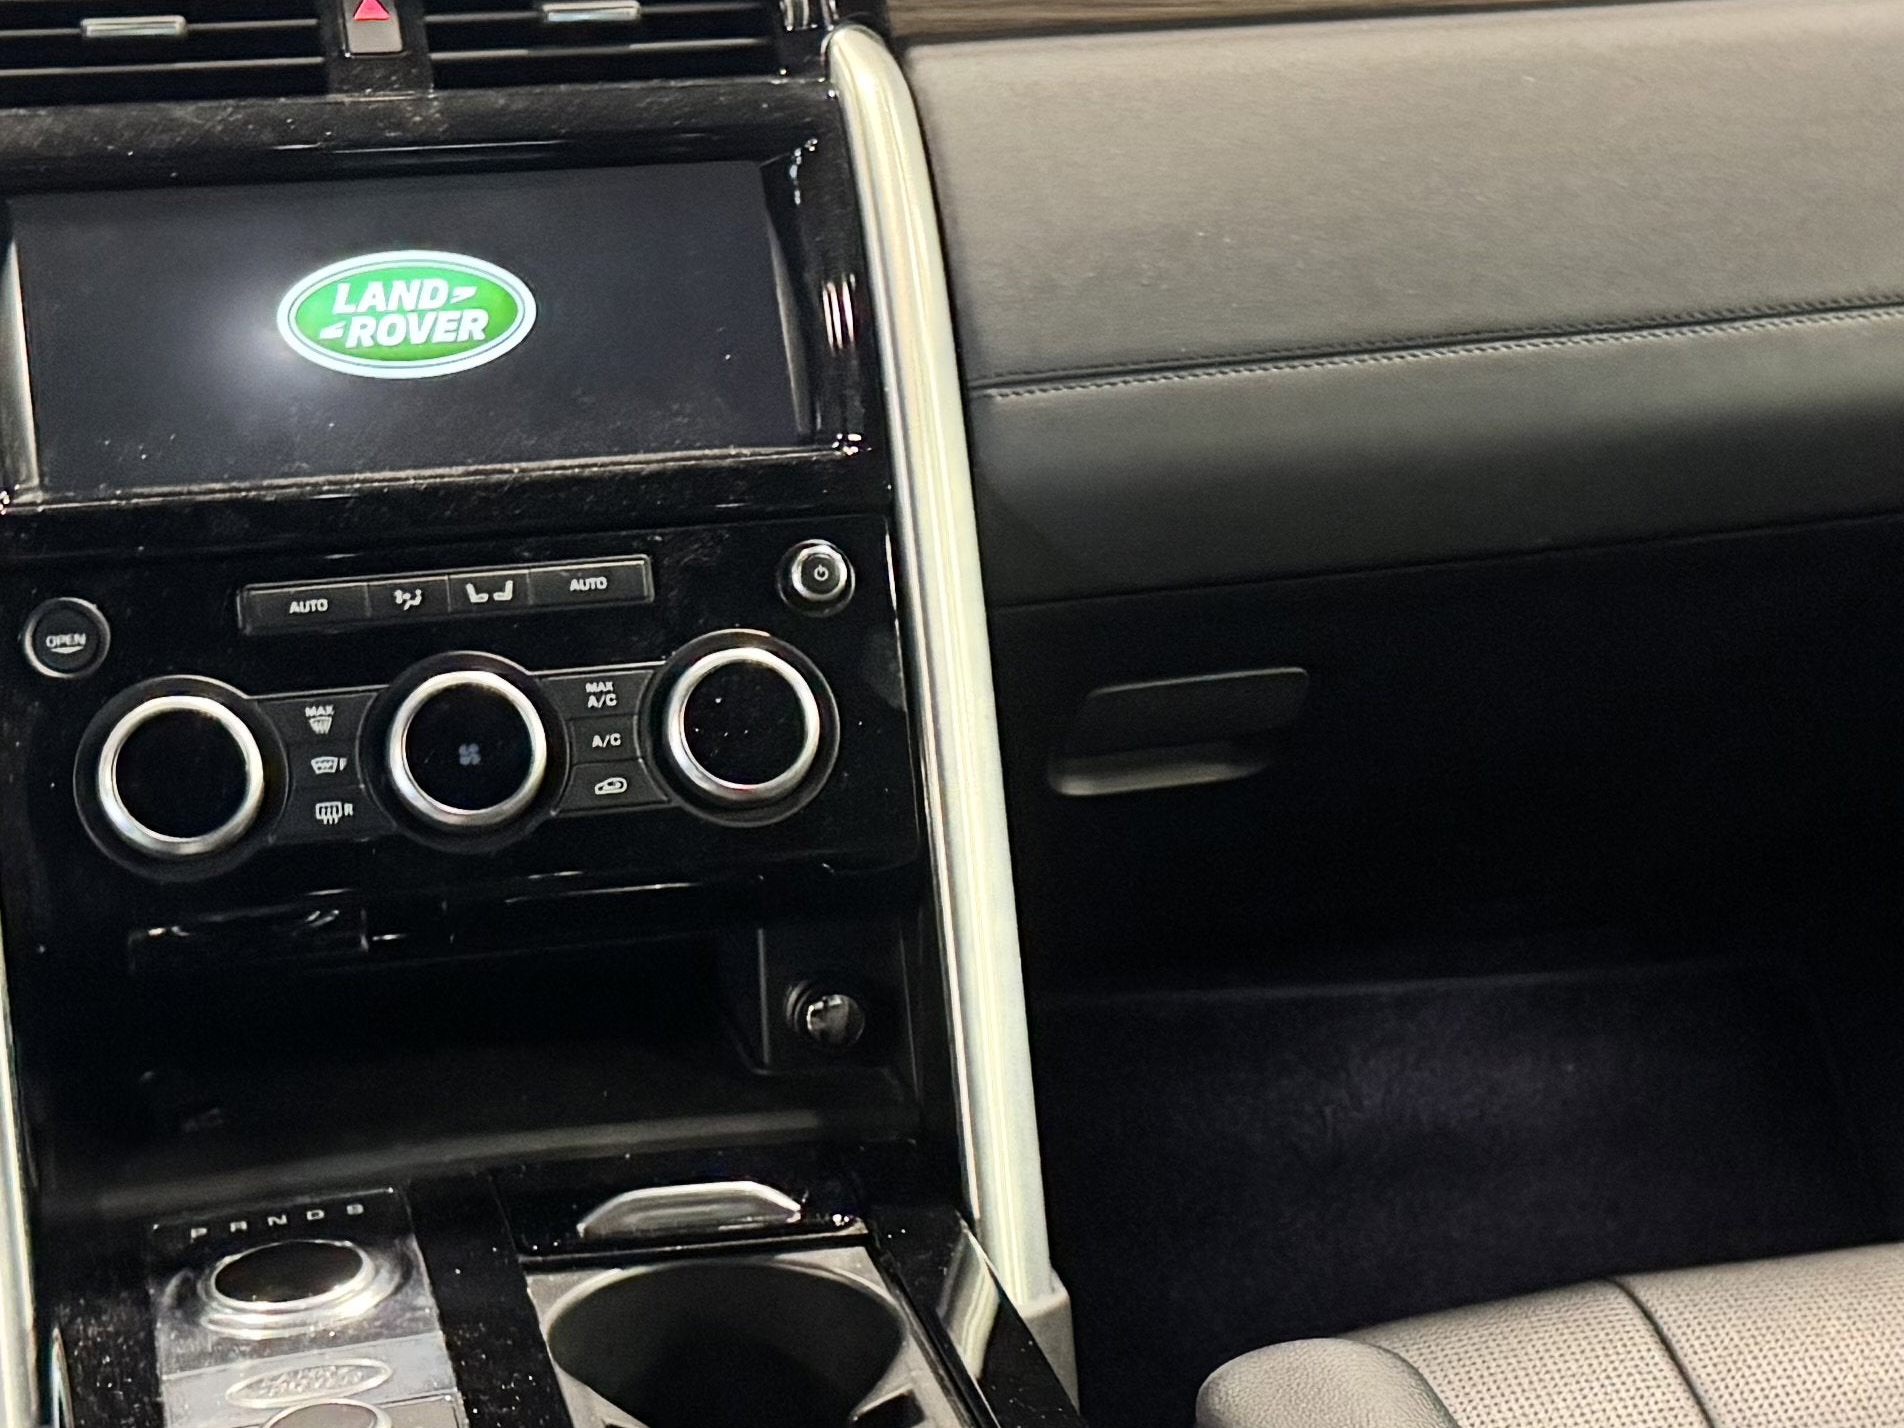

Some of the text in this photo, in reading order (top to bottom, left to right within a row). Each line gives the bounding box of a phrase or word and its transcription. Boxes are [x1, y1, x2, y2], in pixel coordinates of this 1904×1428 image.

[332, 278, 449, 315] LAND
[345, 308, 489, 349] ROVER
[564, 576, 608, 592] AUTO
[288, 597, 329, 614] AUTO
[45, 632, 86, 648] OPEN
[585, 681, 614, 693] MAX
[587, 693, 618, 709] A/C
[304, 704, 335, 718] MAX
[591, 733, 622, 748] A/C
[267, 1214, 288, 1227] N
[306, 1209, 325, 1221] D
